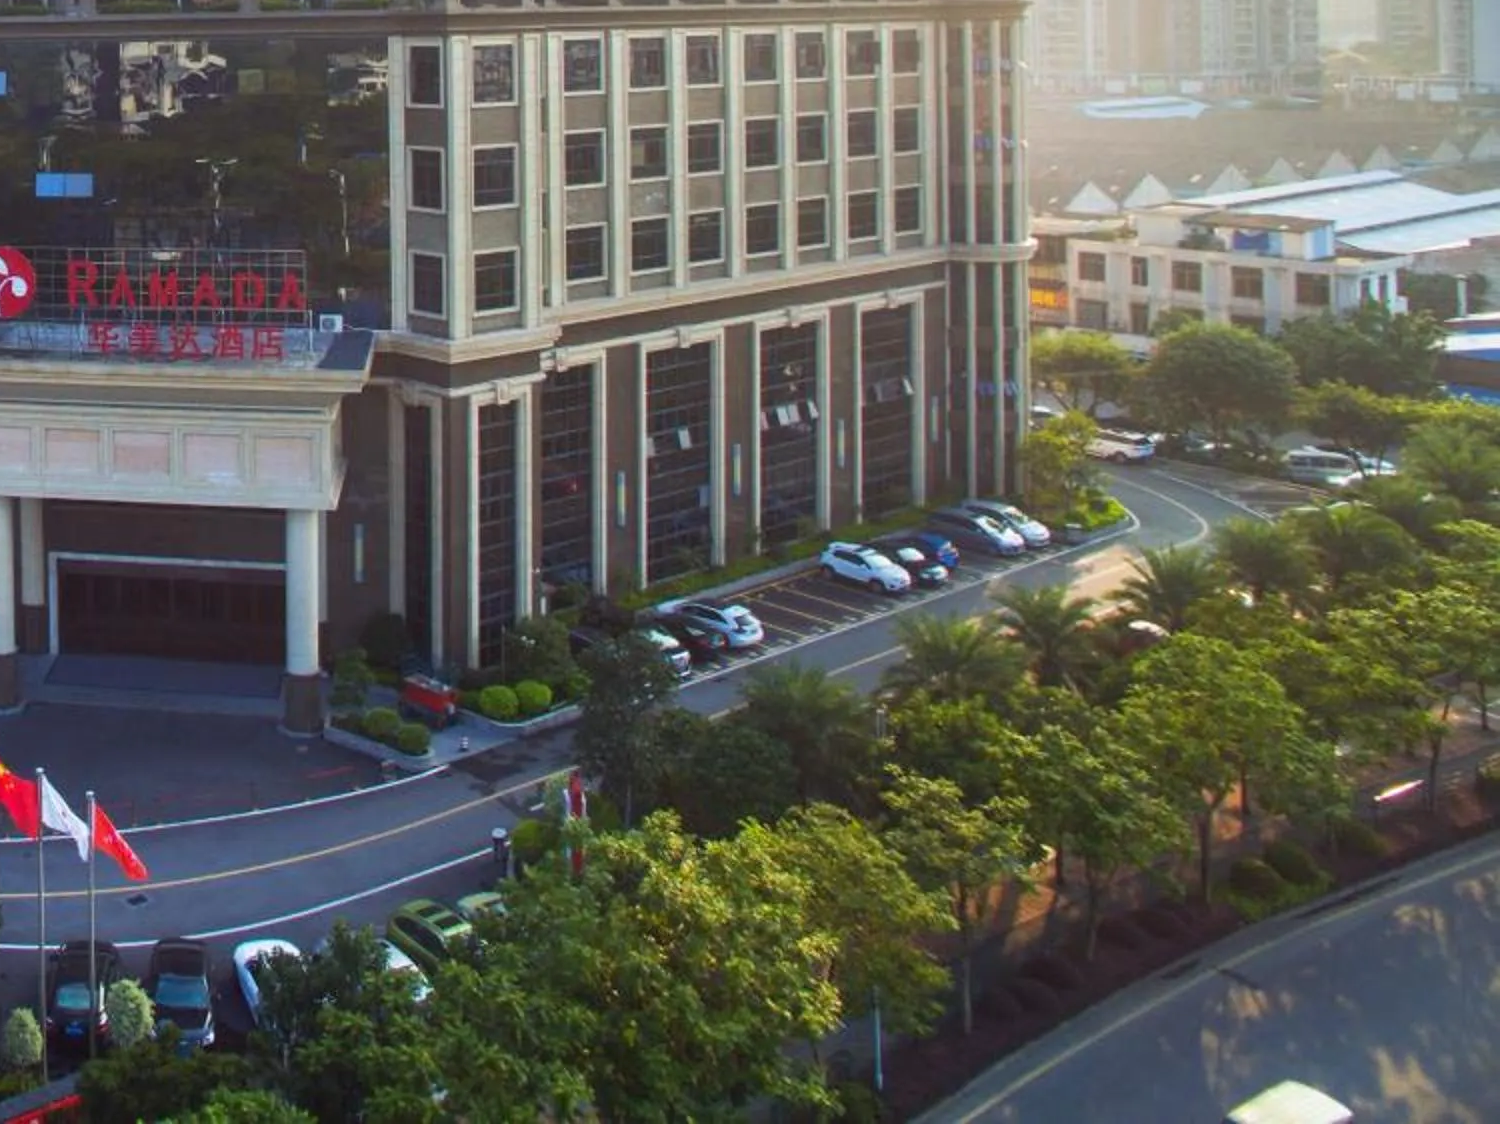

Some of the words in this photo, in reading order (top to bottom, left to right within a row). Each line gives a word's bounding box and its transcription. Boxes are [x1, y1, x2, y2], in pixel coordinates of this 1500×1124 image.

[67, 259, 308, 310] RAMADA
[87, 322, 286, 362] 华美达酒店
